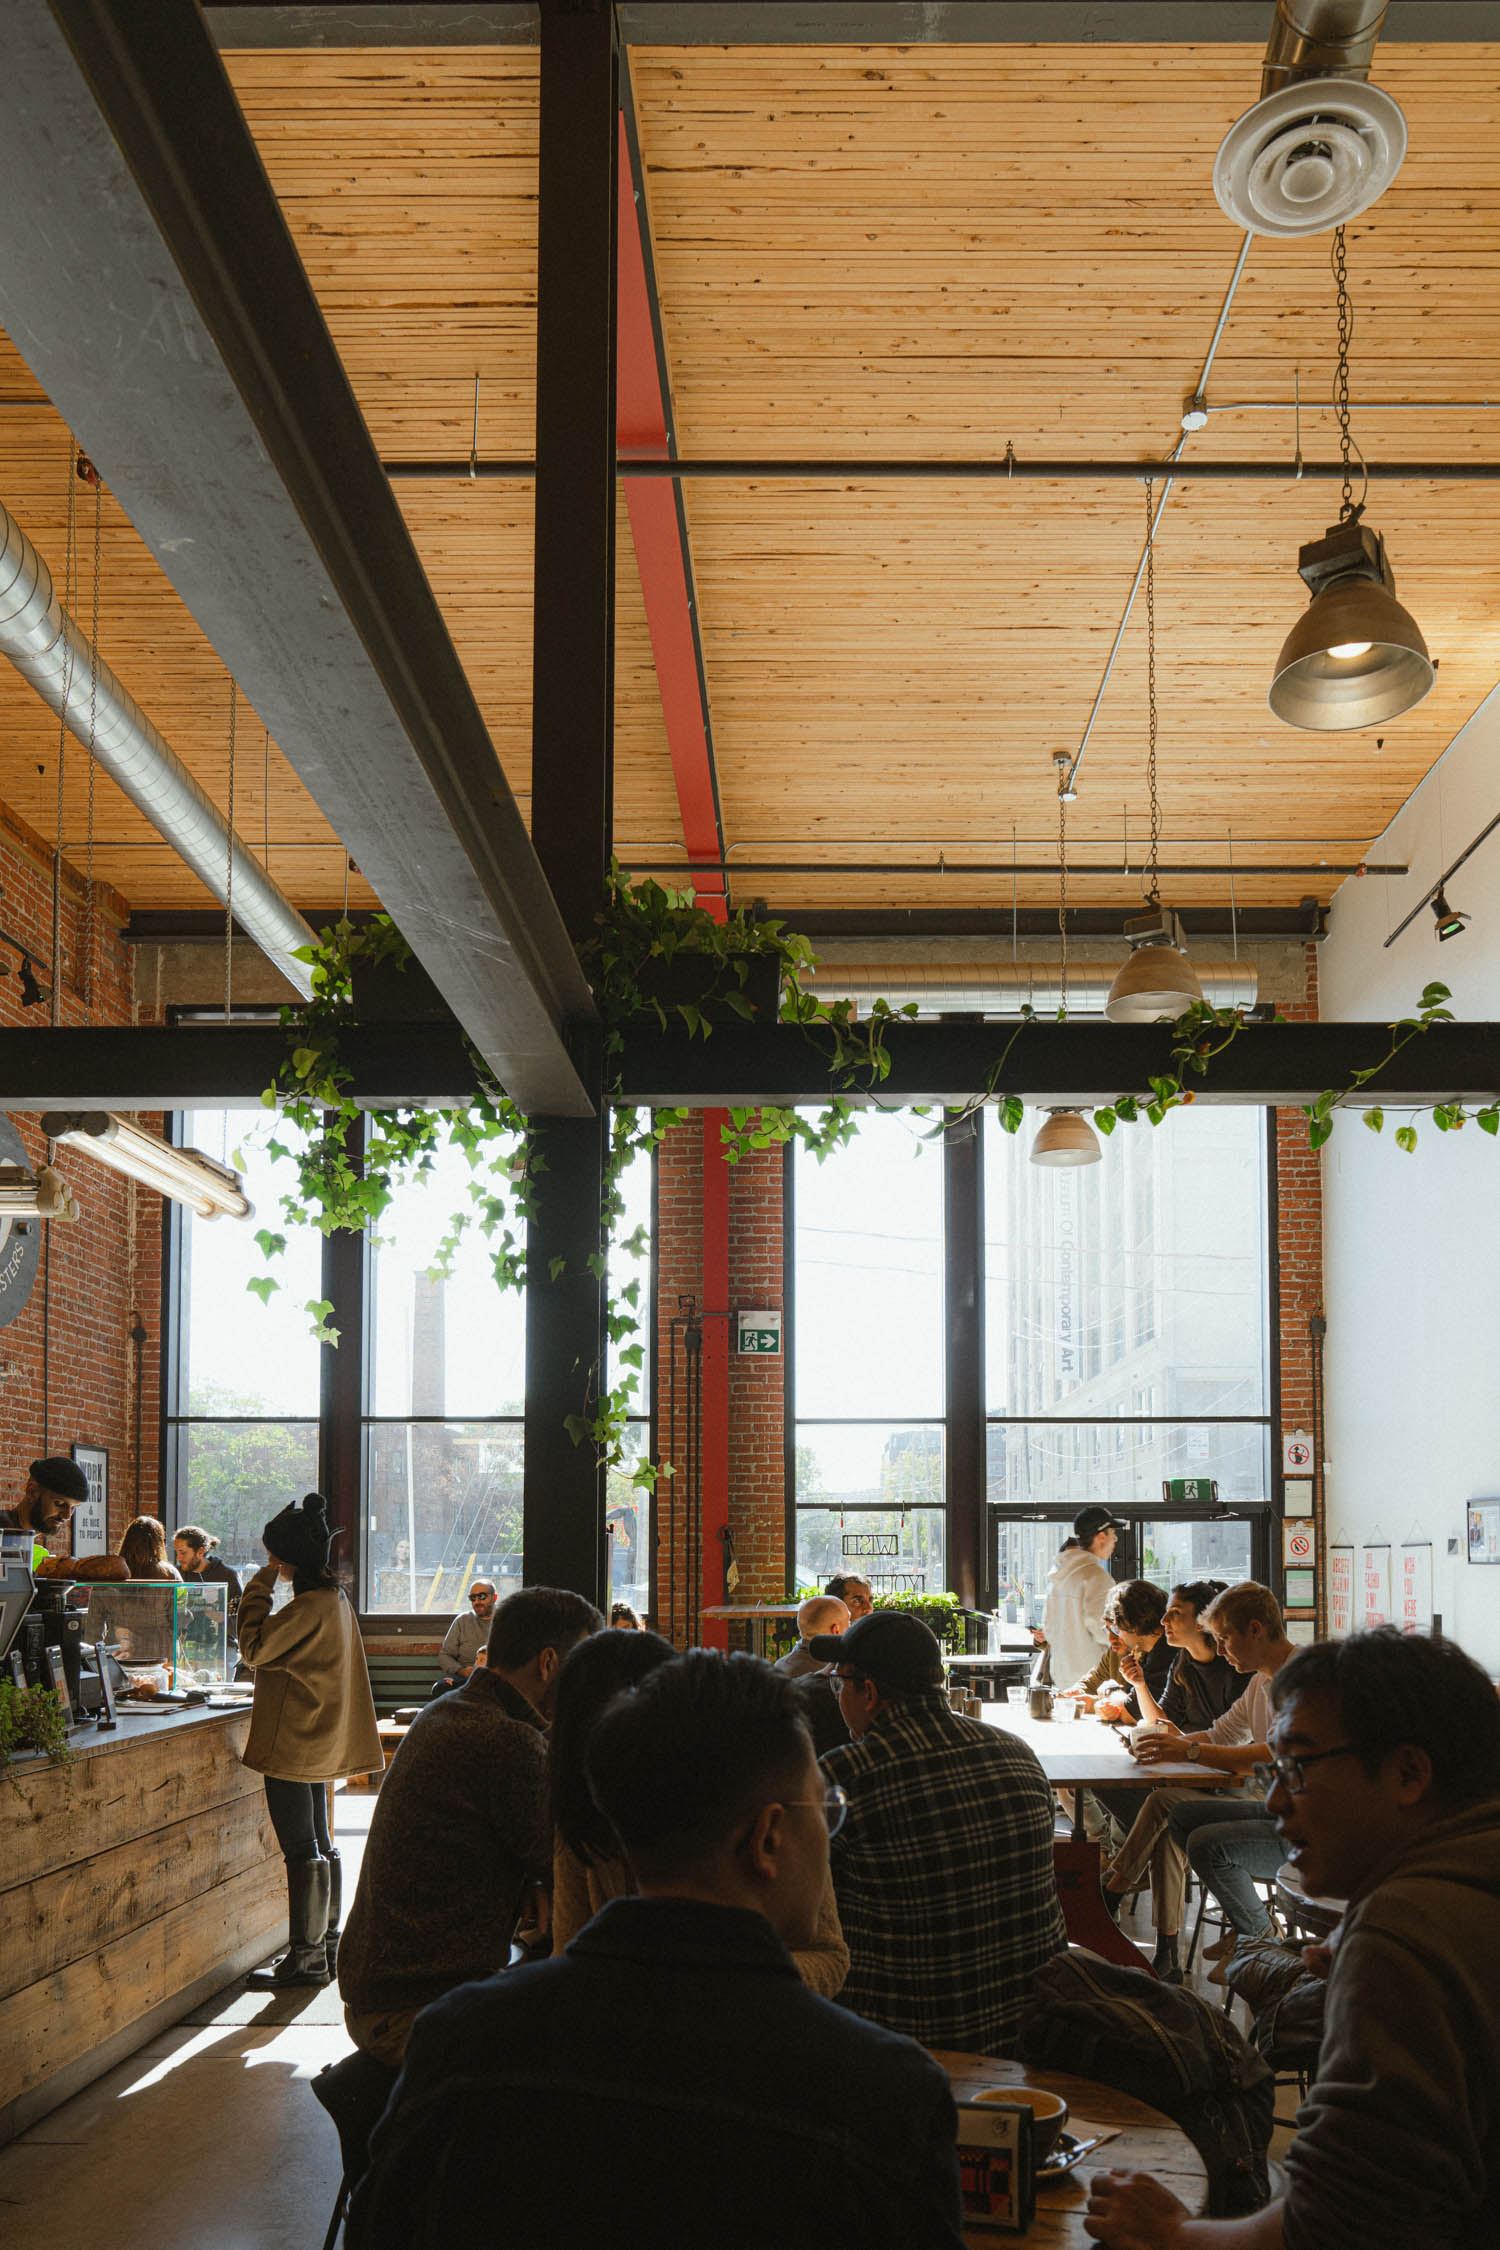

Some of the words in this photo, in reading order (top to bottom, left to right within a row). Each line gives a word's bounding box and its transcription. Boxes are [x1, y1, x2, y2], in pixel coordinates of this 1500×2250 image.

[0, 1241, 24, 1293] STERS
[1058, 1241, 1074, 1343] Contemporary
[1061, 1348, 1074, 1373] Art
[88, 1505, 94, 1515] &
[82, 1518, 88, 1527] BE
[90, 1518, 100, 1528] NICE
[80, 1530, 85, 1539] TO
[87, 1530, 103, 1540] PEOPLE
